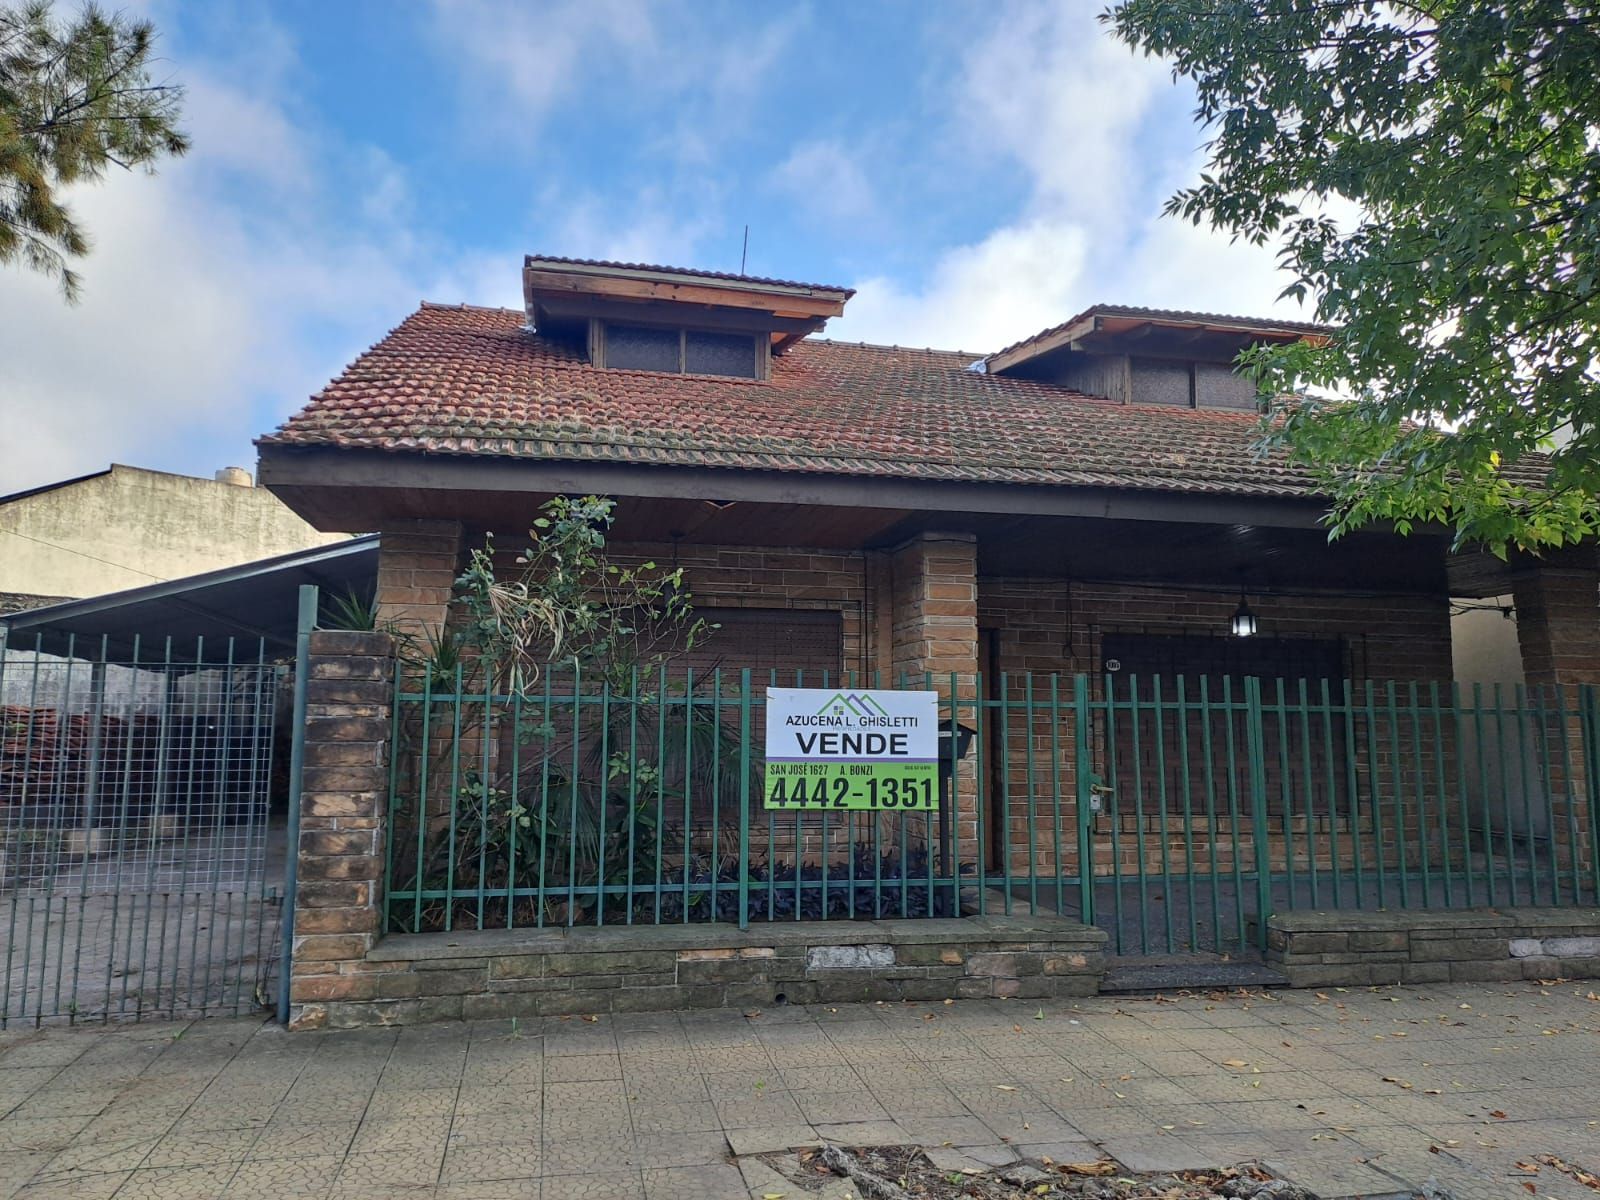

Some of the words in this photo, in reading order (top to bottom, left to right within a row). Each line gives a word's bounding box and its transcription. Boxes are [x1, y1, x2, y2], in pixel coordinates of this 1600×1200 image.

[786, 715, 842, 726] AZUCENA
[845, 716, 856, 727] L.
[859, 716, 918, 727] GHISLETTI
[796, 732, 909, 755] VENDE
[770, 765, 787, 776] SAN
[788, 763, 807, 776] JOSÉ
[809, 765, 829, 776] 1627
[840, 765, 847, 776] A.
[849, 765, 873, 776] BONZI
[769, 777, 932, 808] 4442-1351
